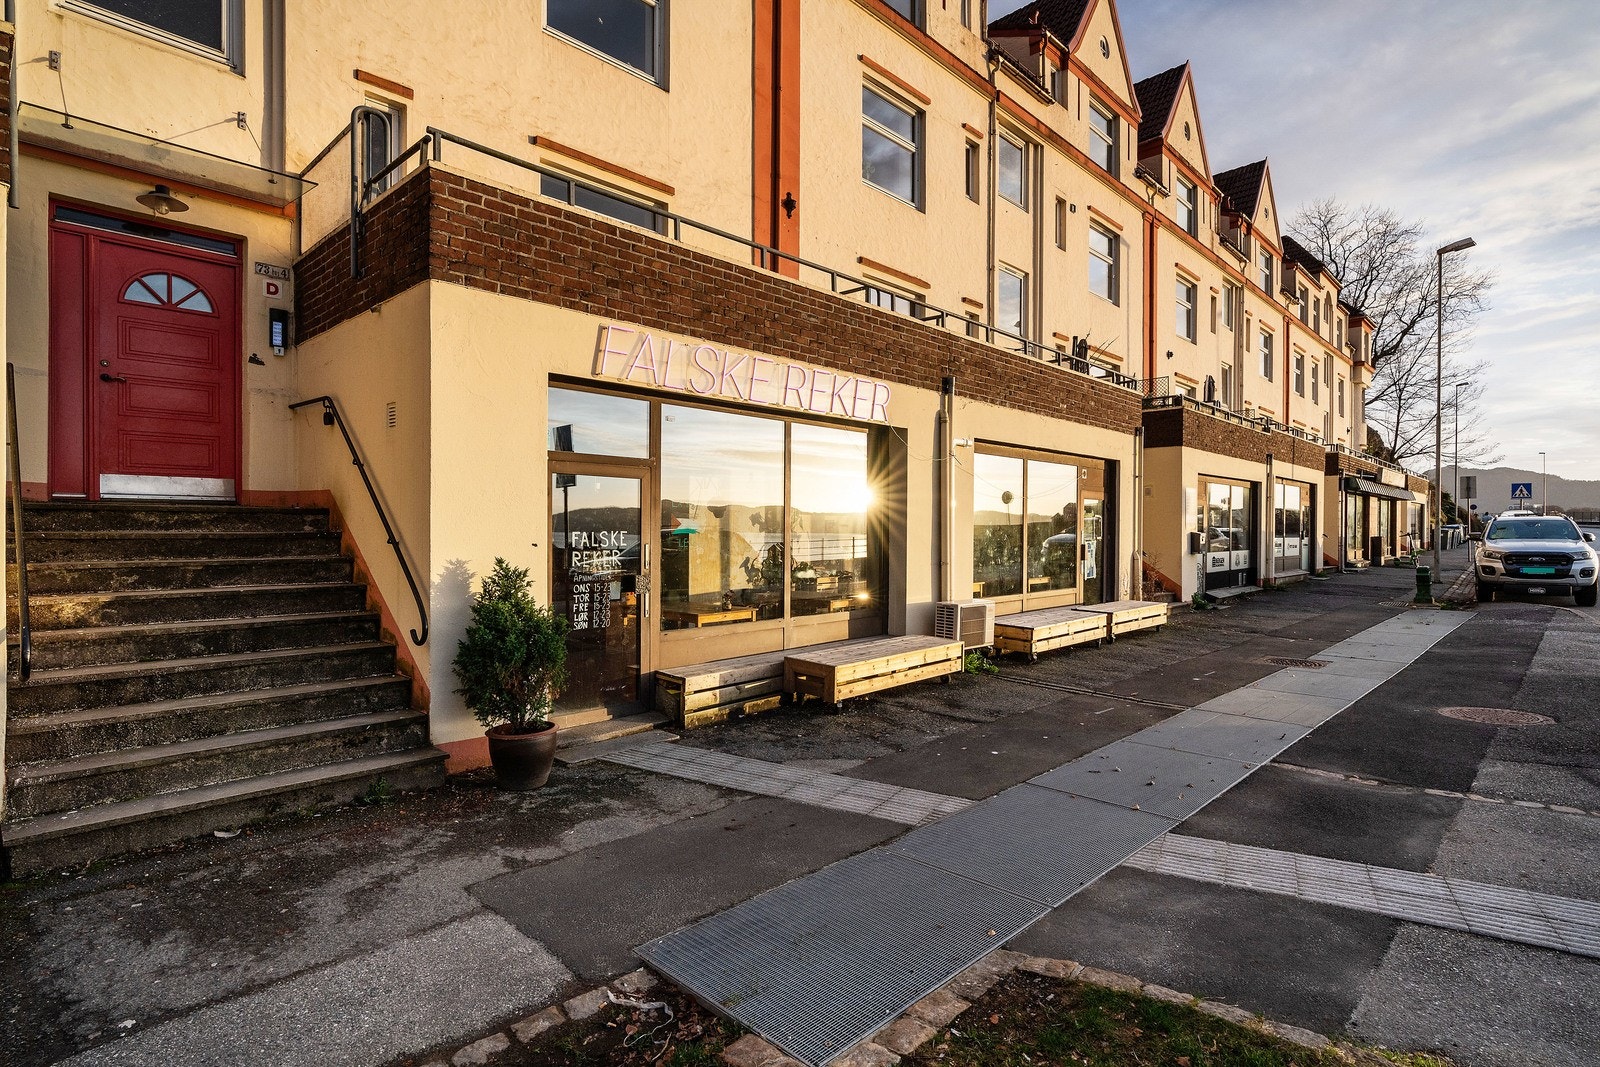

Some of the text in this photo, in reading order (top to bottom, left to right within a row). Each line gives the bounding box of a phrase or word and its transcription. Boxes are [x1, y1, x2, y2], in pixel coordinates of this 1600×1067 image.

[257, 263, 270, 275] 73
[280, 269, 288, 279] 4
[266, 282, 280, 296] D
[600, 325, 892, 422] FALSKE REKER
[571, 530, 628, 548] FALSKE
[572, 550, 622, 568] REKER
[573, 583, 591, 593] ONS
[572, 592, 611, 604] TOR 15-23
[573, 602, 611, 613] FRE 15-23
[573, 610, 611, 622] LØR 12-23
[573, 619, 611, 631] SØN 12-20
